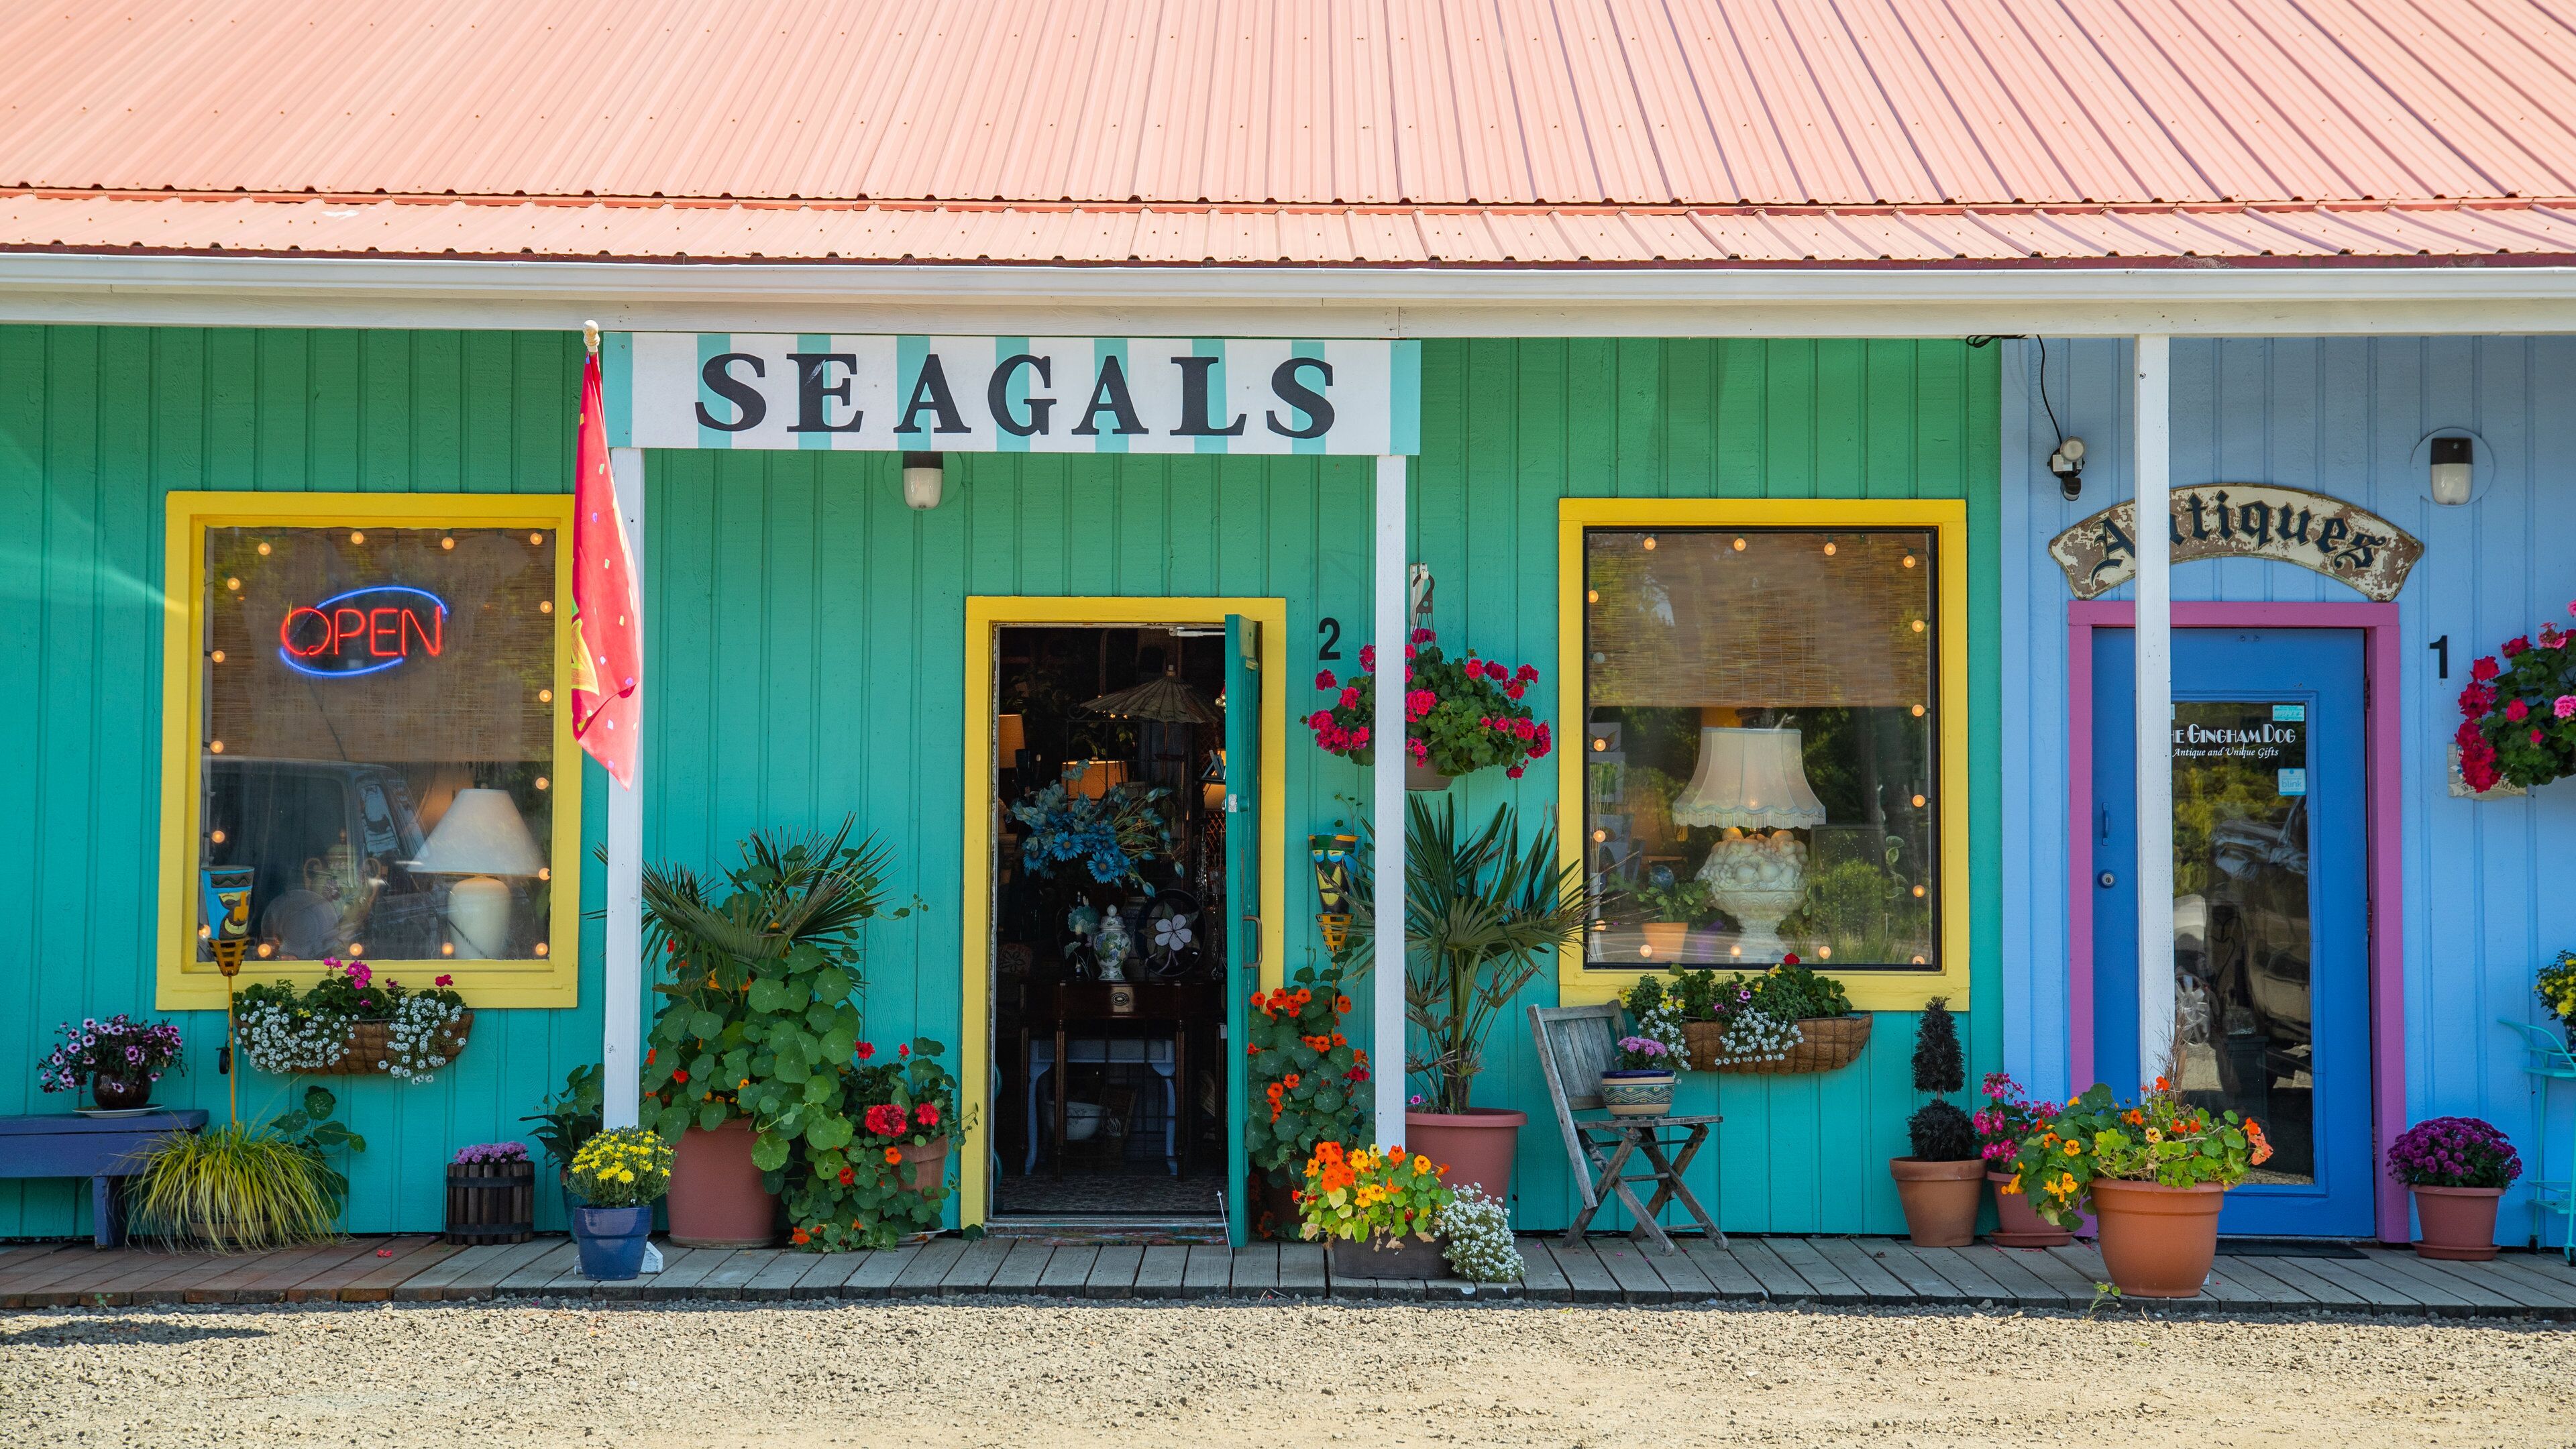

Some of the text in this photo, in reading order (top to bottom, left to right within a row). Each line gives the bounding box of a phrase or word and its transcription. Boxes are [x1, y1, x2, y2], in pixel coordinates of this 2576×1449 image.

[695, 353, 1335, 439] SEAGALS
[280, 605, 443, 657] OPEN
[1319, 617, 1341, 660] 2
[2430, 635, 2448, 678] 1
[2172, 747, 2279, 759] Antique and Unique Gifts
[2187, 723, 2261, 743] GINGHAM
[2263, 724, 2296, 743] DOG
[2461, 780, 2516, 792] WOME
